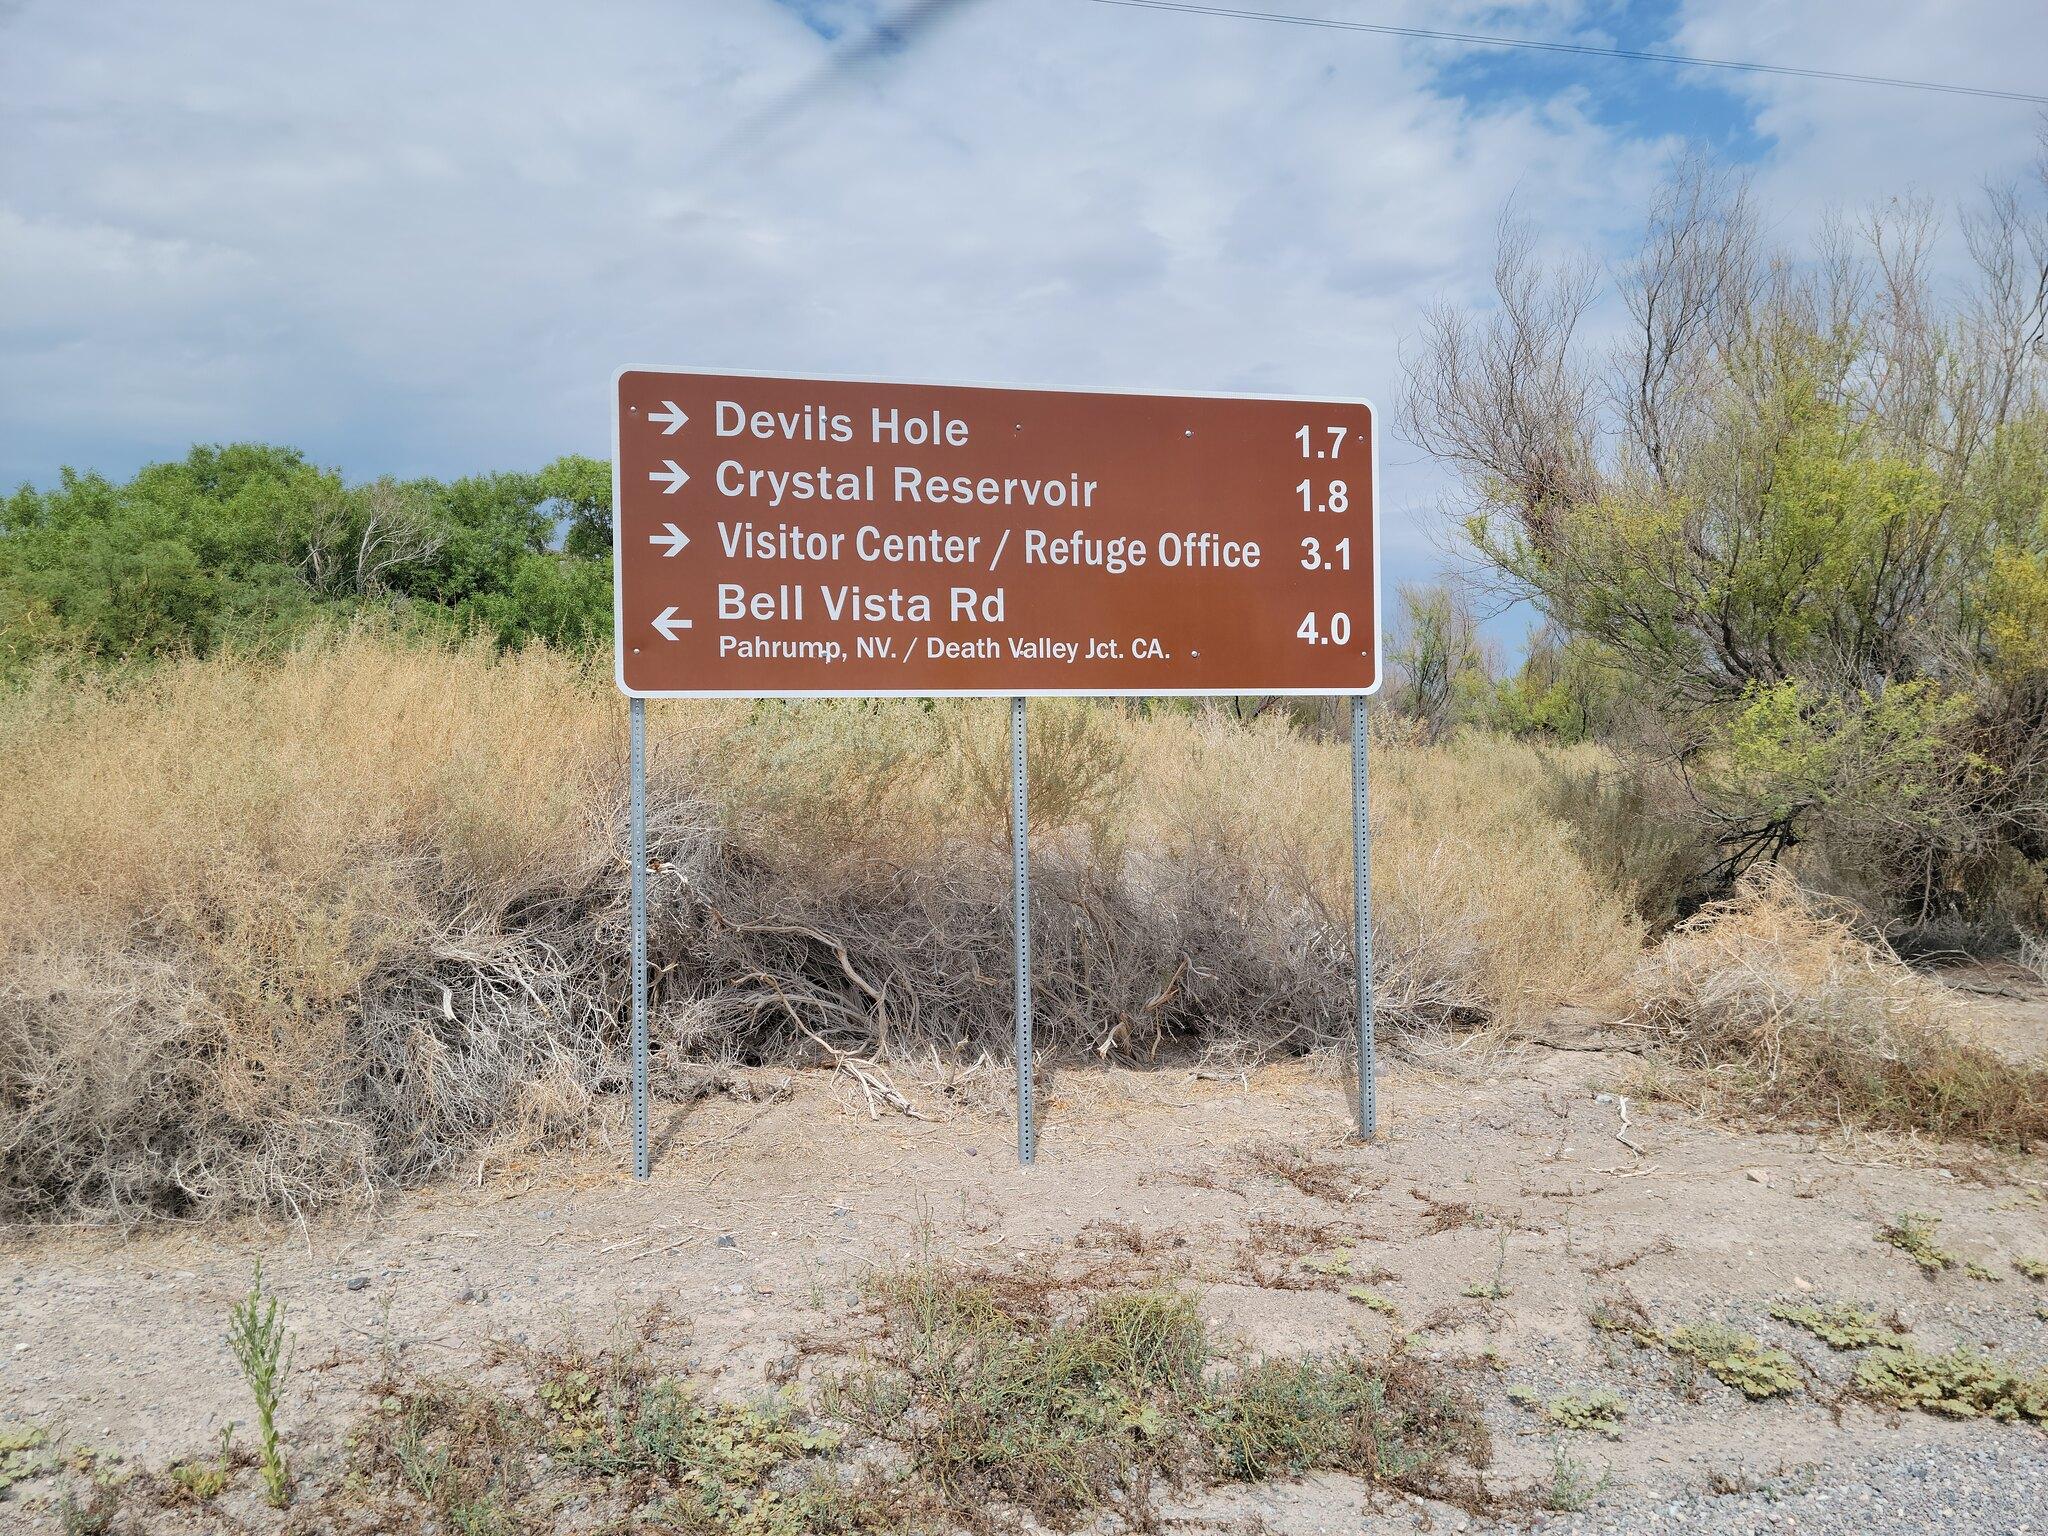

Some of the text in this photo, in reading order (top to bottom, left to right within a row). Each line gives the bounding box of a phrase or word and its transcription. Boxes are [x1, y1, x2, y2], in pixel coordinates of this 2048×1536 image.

[714, 400, 1348, 459] Devils Hole 1.7
[715, 459, 1349, 514] Crystal Reservoir 1.8
[716, 521, 1351, 574] Visitor Center / Refuge Office 3.1
[718, 583, 1351, 646] Bell Vista Rd 4.0
[719, 635, 1171, 665] Pahrump, NV. / Death Valley Jct. CA.
